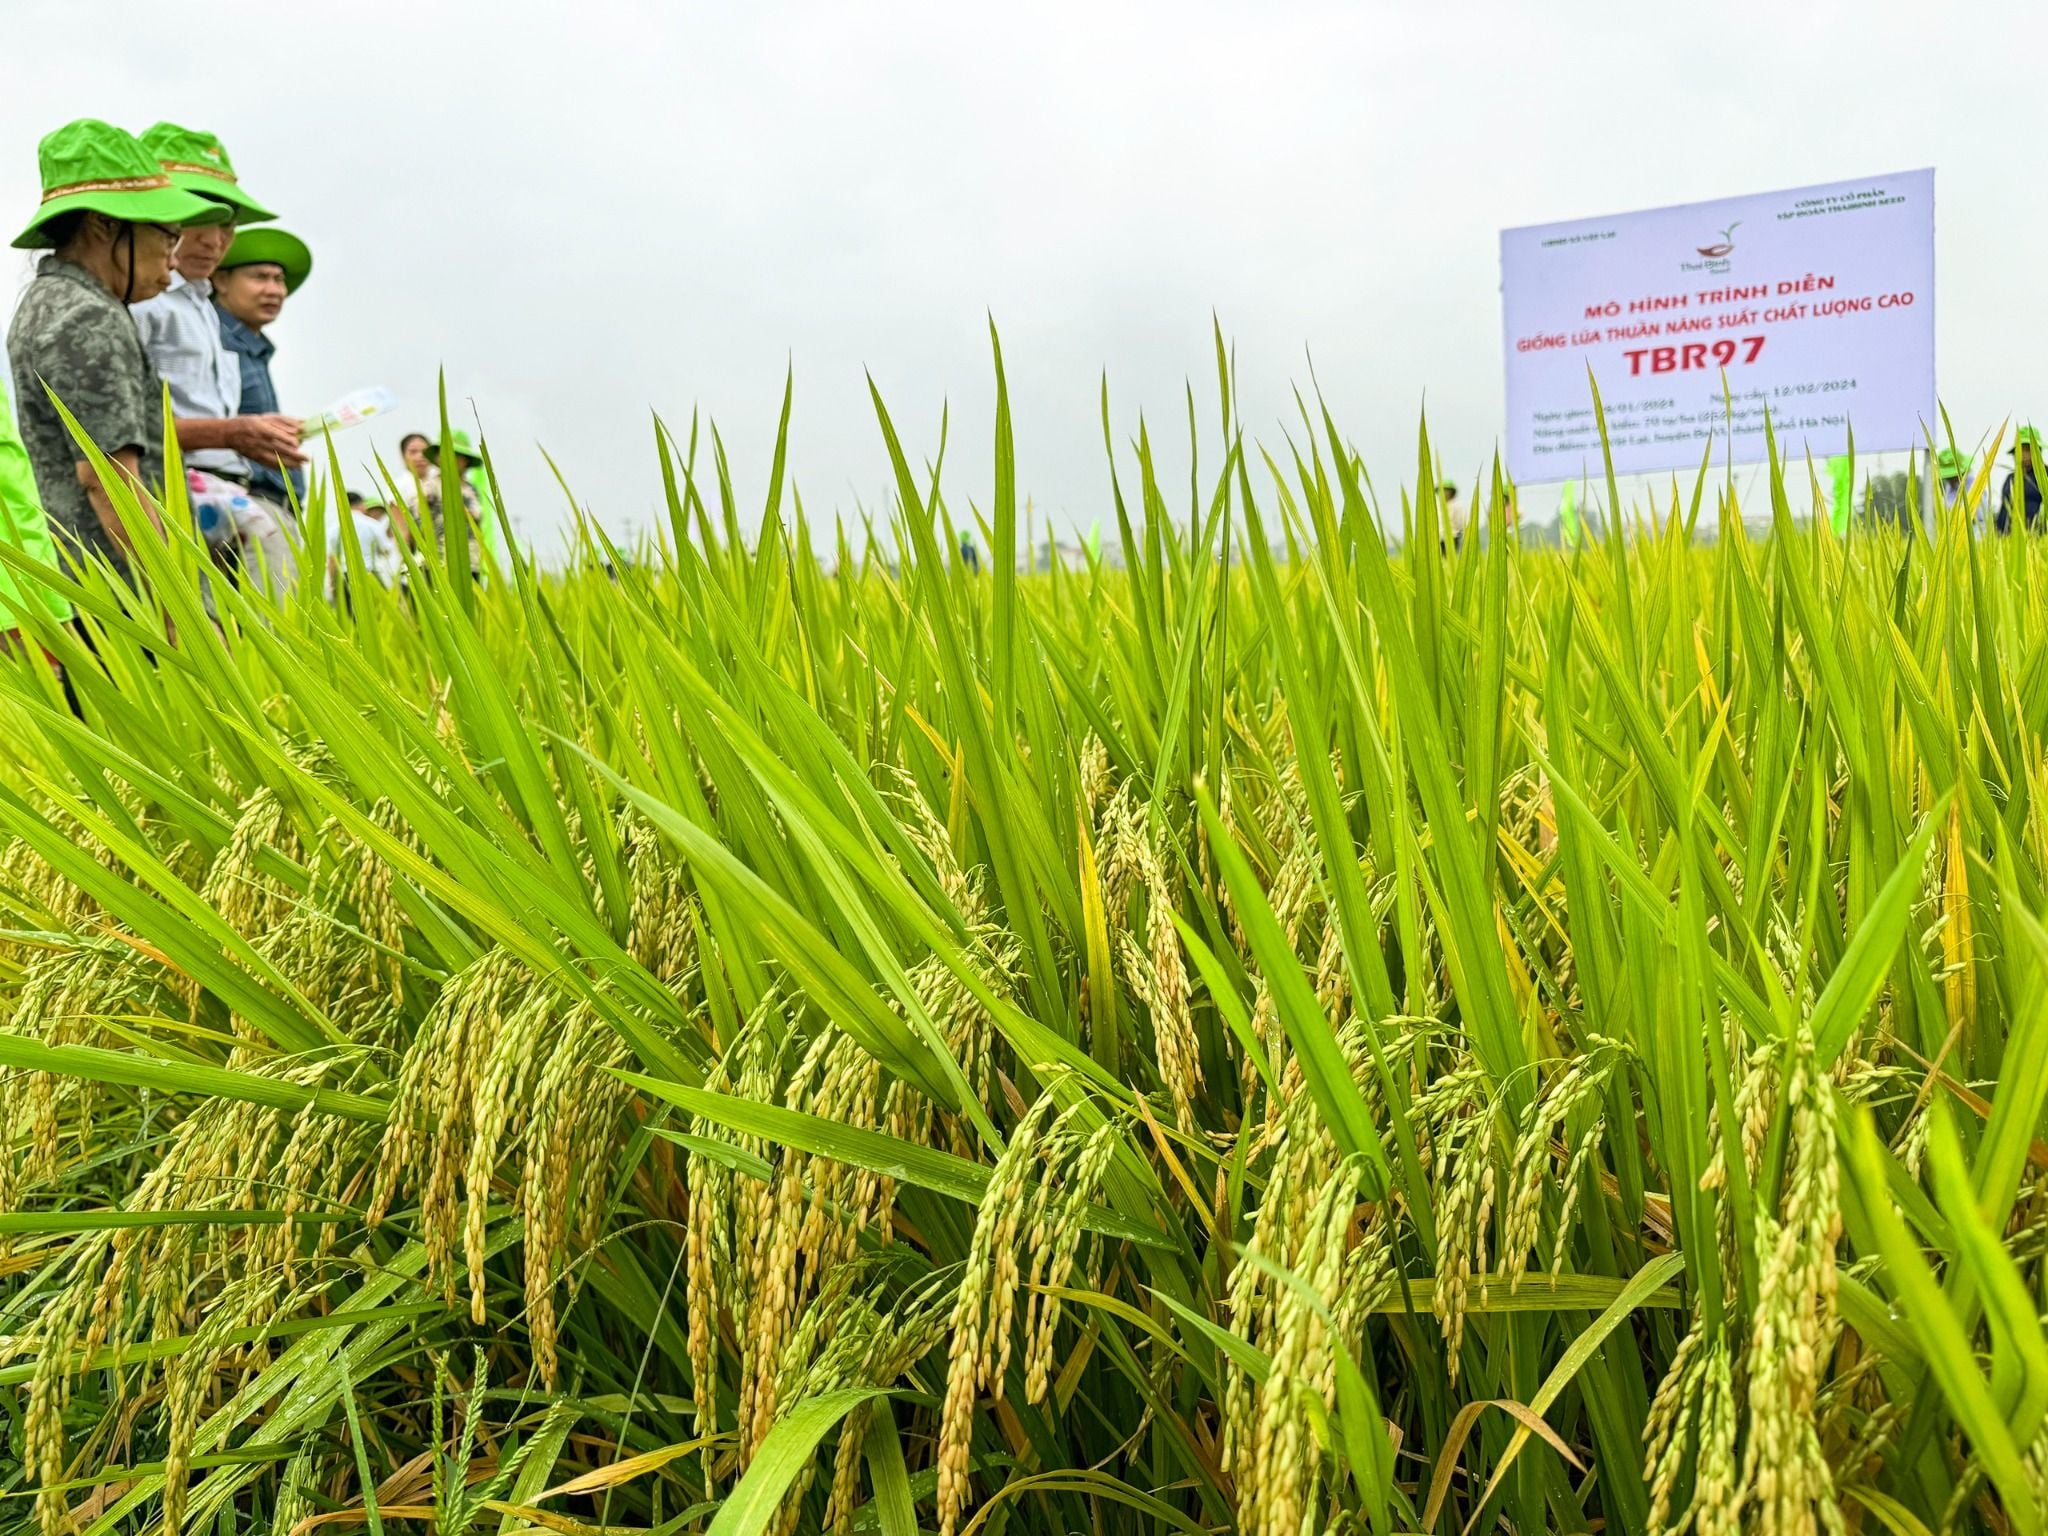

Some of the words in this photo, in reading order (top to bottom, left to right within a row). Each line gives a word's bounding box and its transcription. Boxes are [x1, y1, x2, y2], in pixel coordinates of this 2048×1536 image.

[1584, 301, 1621, 321] MÔ
[1629, 293, 1689, 315] HÌNH
[1697, 284, 1769, 306] TRÌNH
[1777, 272, 1836, 296] DIỄN
[1516, 331, 1568, 353] GIỐNG
[1571, 327, 1602, 346] LÚA
[1607, 320, 1661, 342] THUẦN
[1665, 314, 1713, 335] NĂNG
[1717, 306, 1760, 329] SUẤT
[1763, 300, 1808, 323] CHẤT
[1812, 296, 1873, 319] LƯỢNG
[1877, 291, 1915, 308] CAO
[1623, 335, 1767, 377] TBR97
